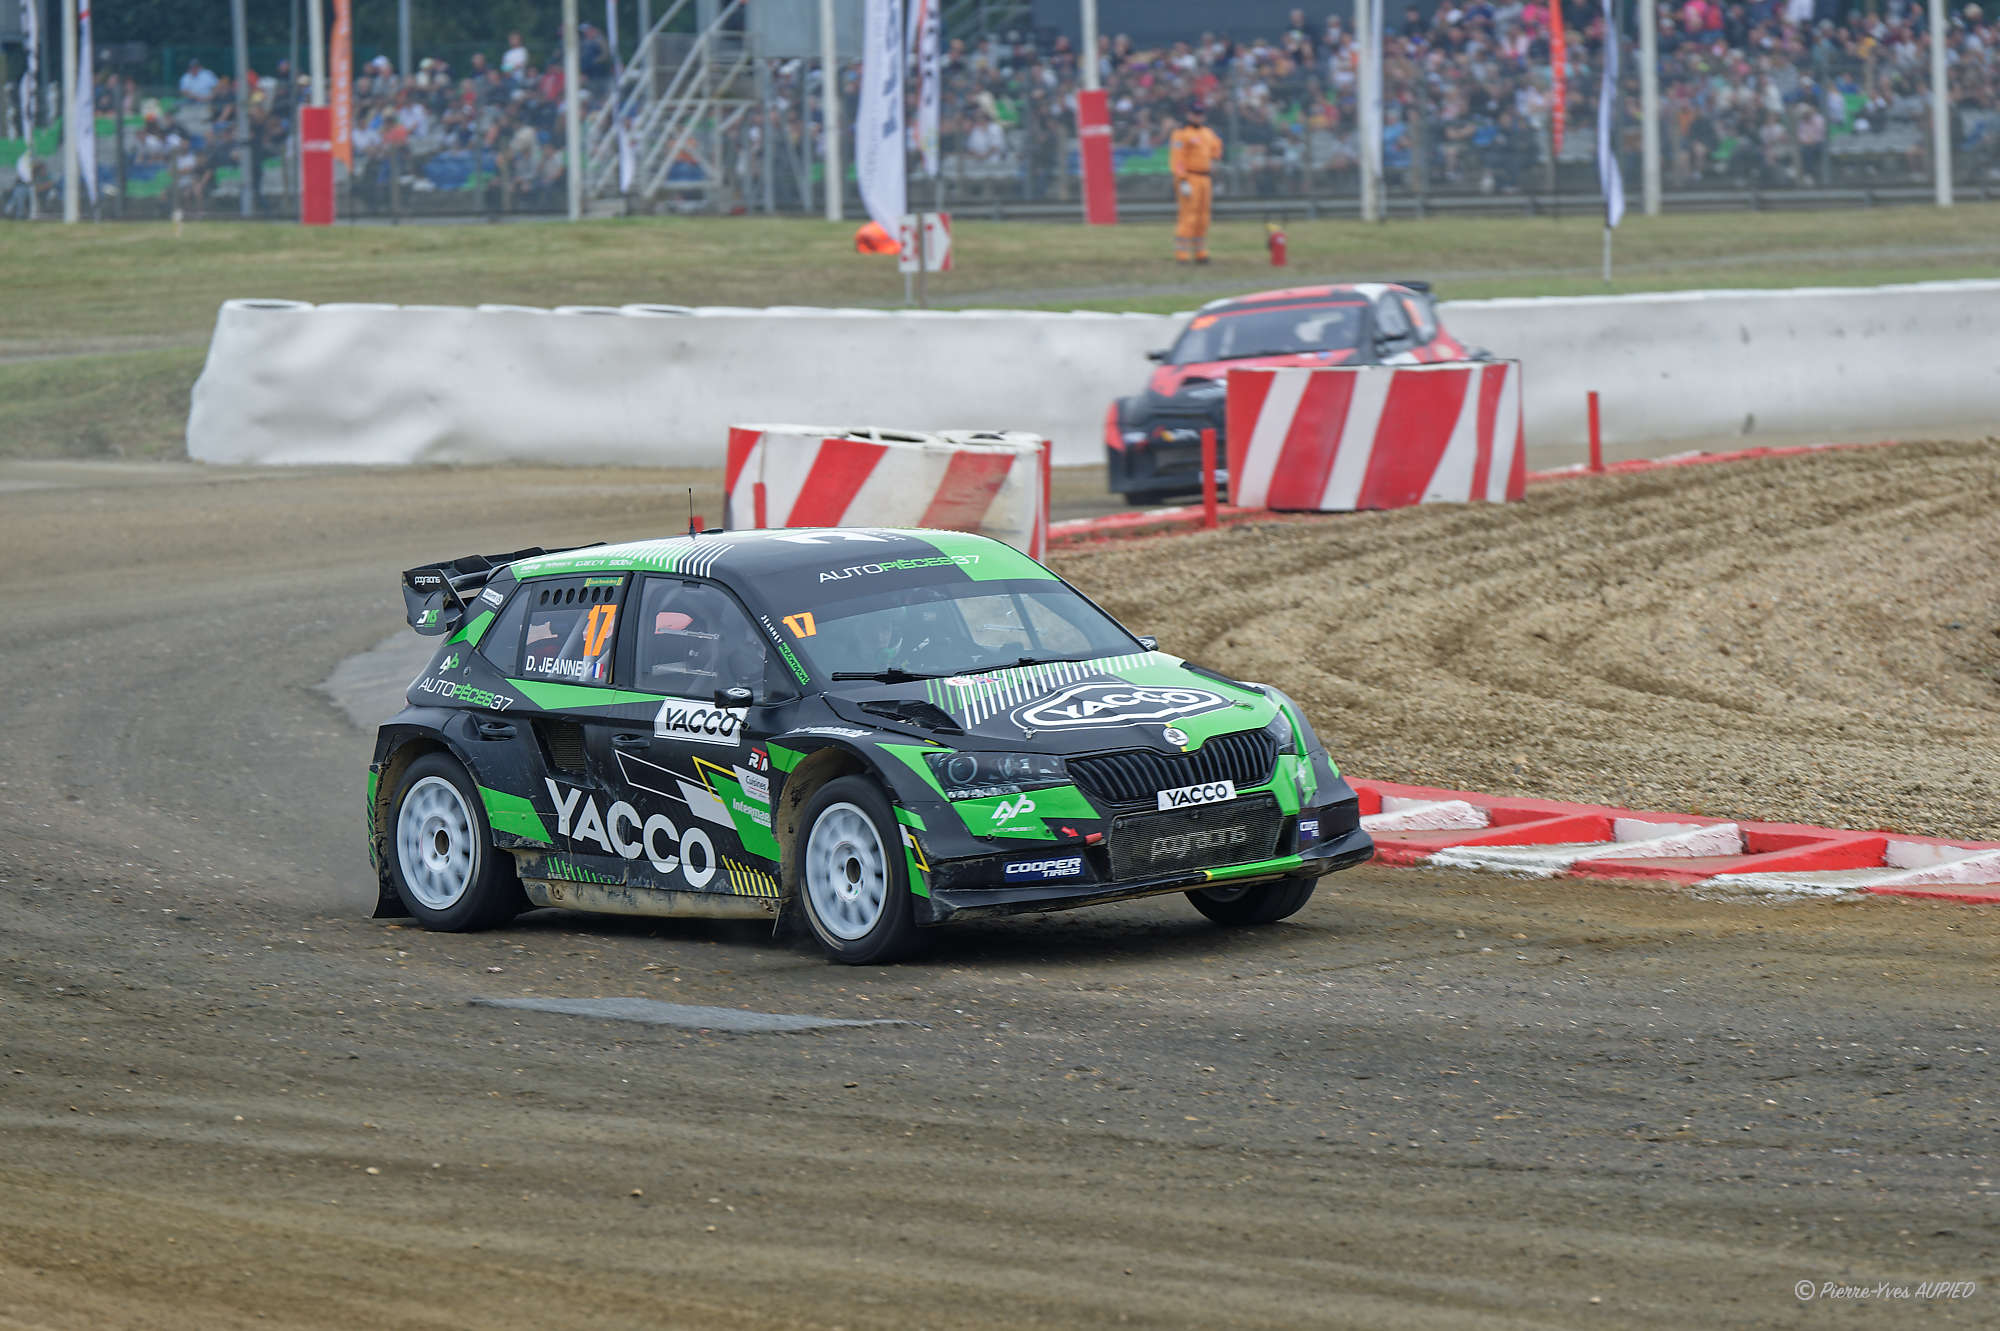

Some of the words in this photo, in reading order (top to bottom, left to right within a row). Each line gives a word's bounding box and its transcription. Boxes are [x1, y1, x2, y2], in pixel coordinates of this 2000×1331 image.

[583, 604, 618, 657] 17
[782, 611, 817, 639] 17
[525, 655, 537, 672] D.
[538, 656, 593, 678] JEANNEY
[1044, 691, 1200, 719] YACCO
[665, 707, 738, 737] YACCO
[1167, 783, 1227, 806] YACCO
[545, 777, 716, 888] YACCO
[1005, 857, 1082, 874] COOPER
[1041, 867, 1081, 878] TIRES
